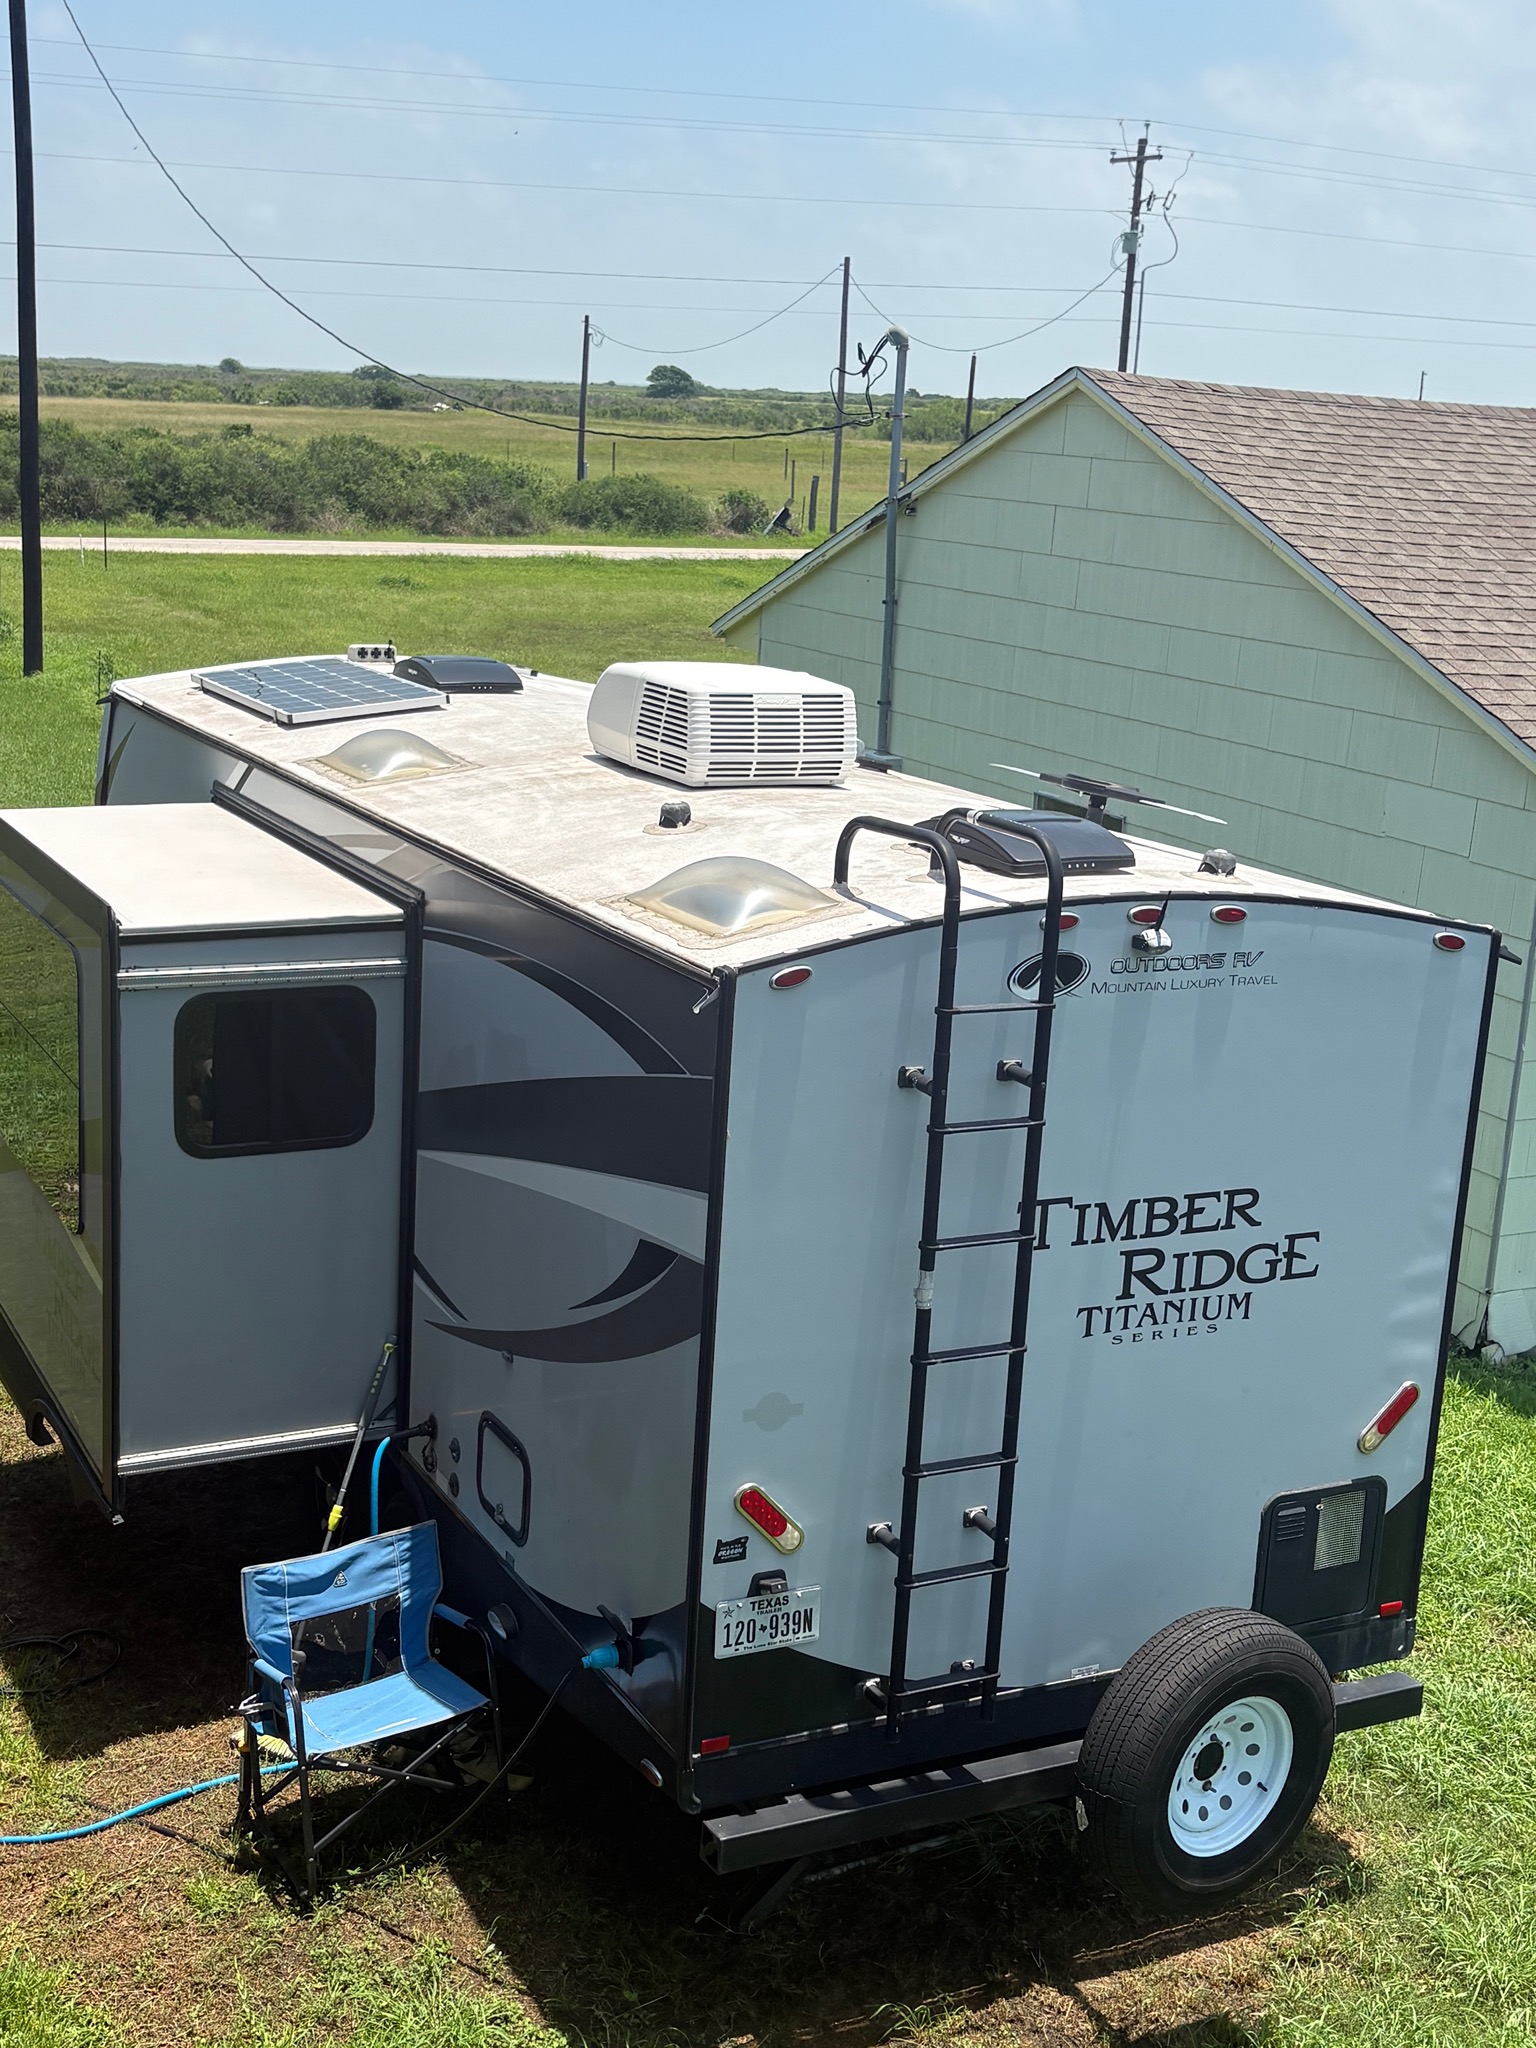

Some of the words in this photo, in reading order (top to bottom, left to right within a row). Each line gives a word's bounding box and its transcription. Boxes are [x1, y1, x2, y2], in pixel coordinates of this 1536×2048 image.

[1110, 952, 1227, 974] OUTDOORS
[1232, 951, 1264, 968] RV
[1091, 980, 1166, 994] MOUNTAIN
[1170, 977, 1225, 990] LUXURY
[1229, 973, 1278, 986] TRAVEL
[1017, 1188, 1262, 1250] TIMBER
[1115, 1231, 1320, 1300] RIDGE
[1076, 1292, 1253, 1338] TITANIUM
[1111, 1323, 1218, 1345] SERIES
[750, 1595, 789, 1611] TEXAS
[756, 1607, 782, 1616] TRAILER
[723, 1618, 756, 1648] 120
[769, 1608, 813, 1640] 939N
